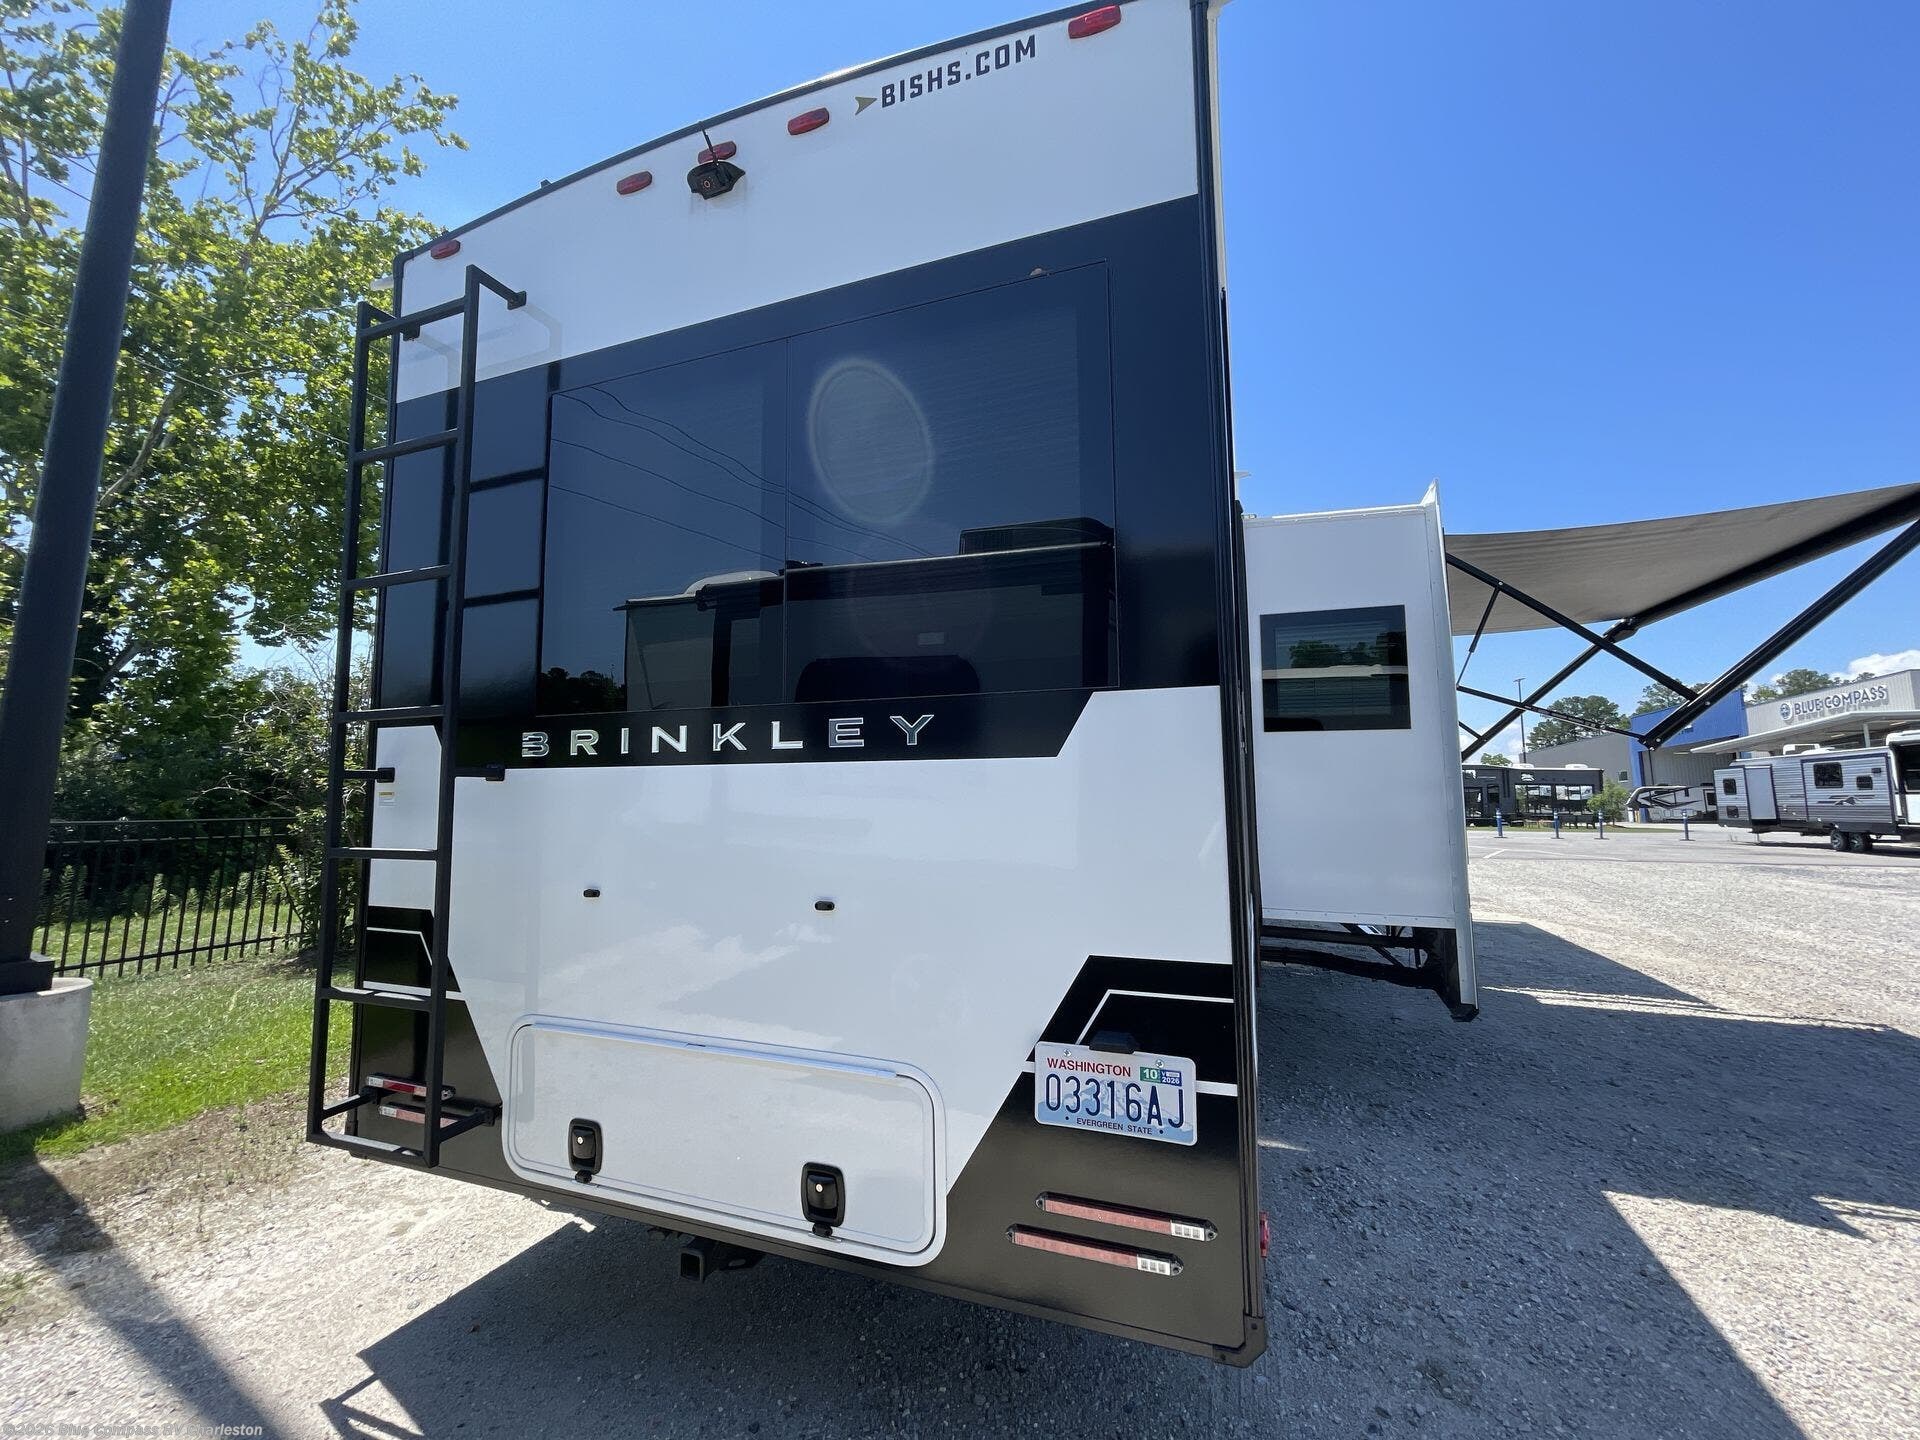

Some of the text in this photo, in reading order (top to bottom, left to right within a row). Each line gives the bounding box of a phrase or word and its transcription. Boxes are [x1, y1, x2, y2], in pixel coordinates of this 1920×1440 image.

[881, 34, 1037, 109] BISHS.COM
[1794, 685, 1886, 715] BLUE COMPASS
[521, 713, 935, 758] BRINKLEY
[1047, 1057, 1131, 1077] WASHINGTON
[1143, 1068, 1158, 1080] 10
[1161, 1076, 1180, 1085] 2026
[1045, 1073, 1184, 1129] 03316AJ
[1076, 1117, 1153, 1135] EVERGREEN STATE
